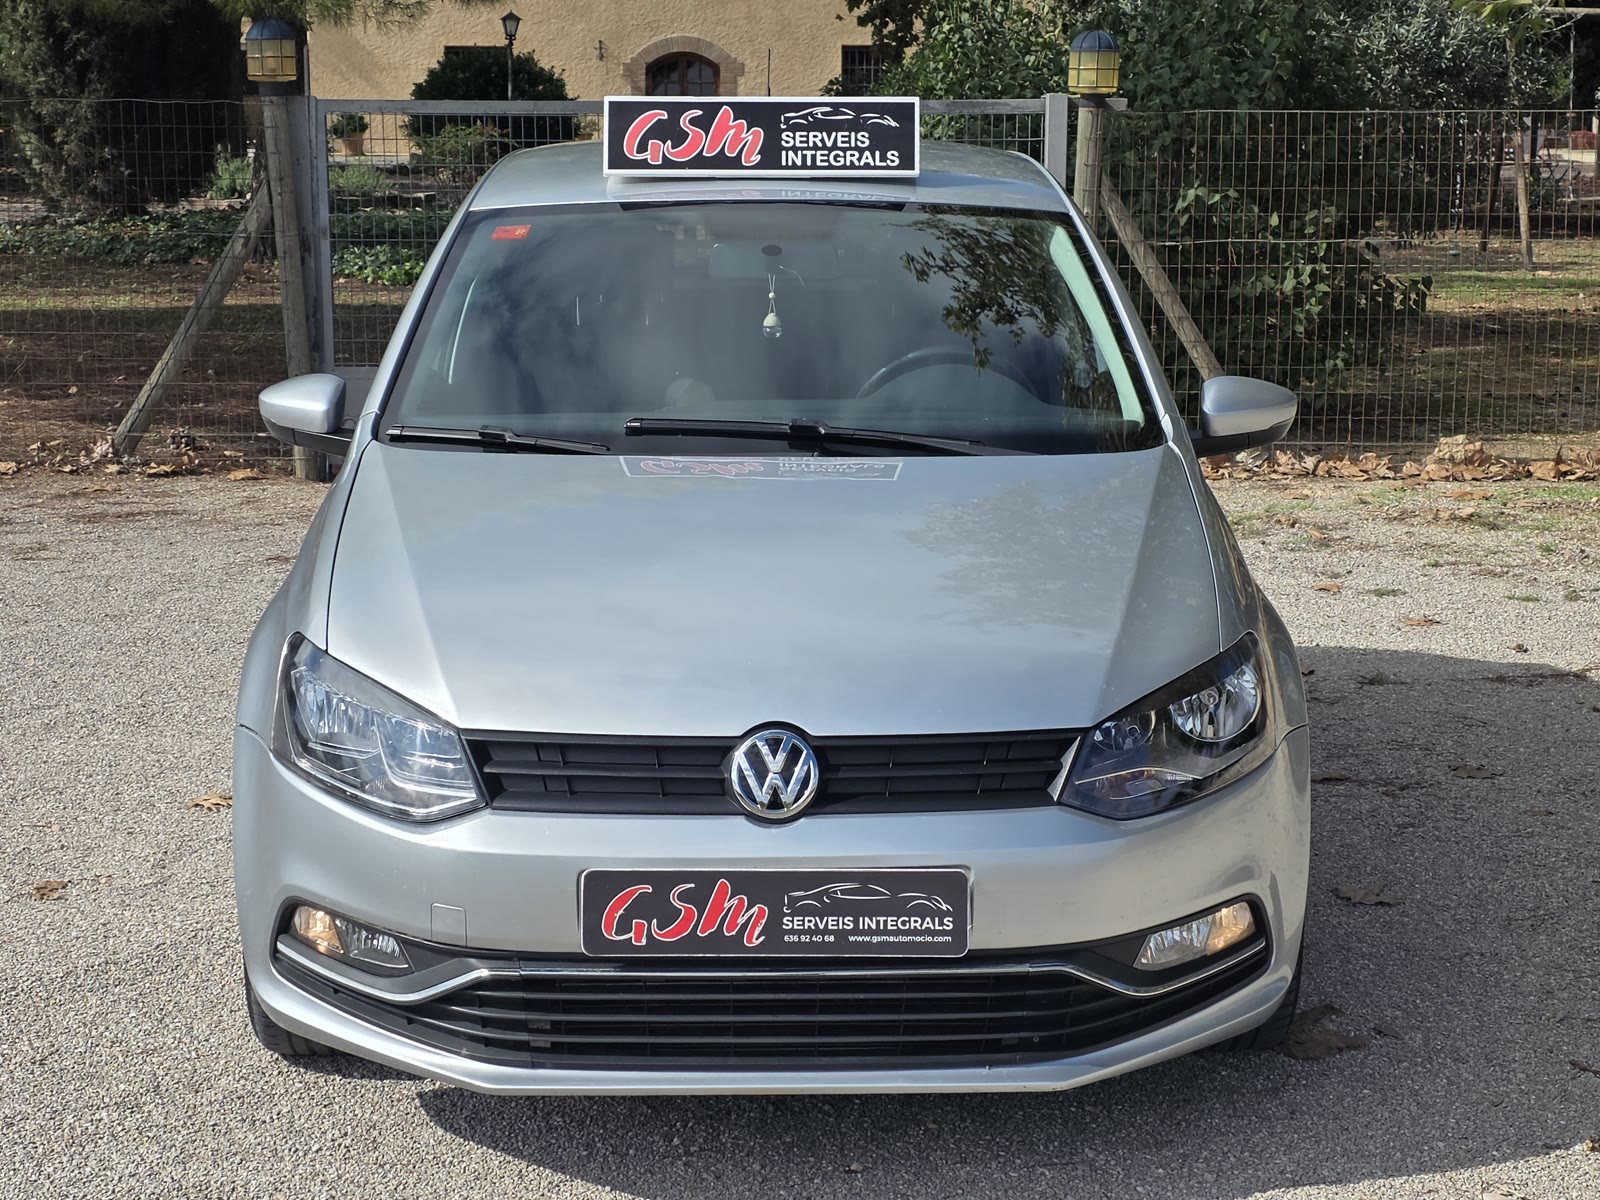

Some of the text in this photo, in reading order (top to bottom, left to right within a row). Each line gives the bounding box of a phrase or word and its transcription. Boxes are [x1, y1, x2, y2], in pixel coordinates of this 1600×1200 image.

[781, 131, 870, 148] SERVEIS
[781, 150, 900, 167] INTEGRALS
[782, 916, 954, 930] SERVEIS INTEGRALS
[848, 934, 952, 943] www.gsmautomocio.com
